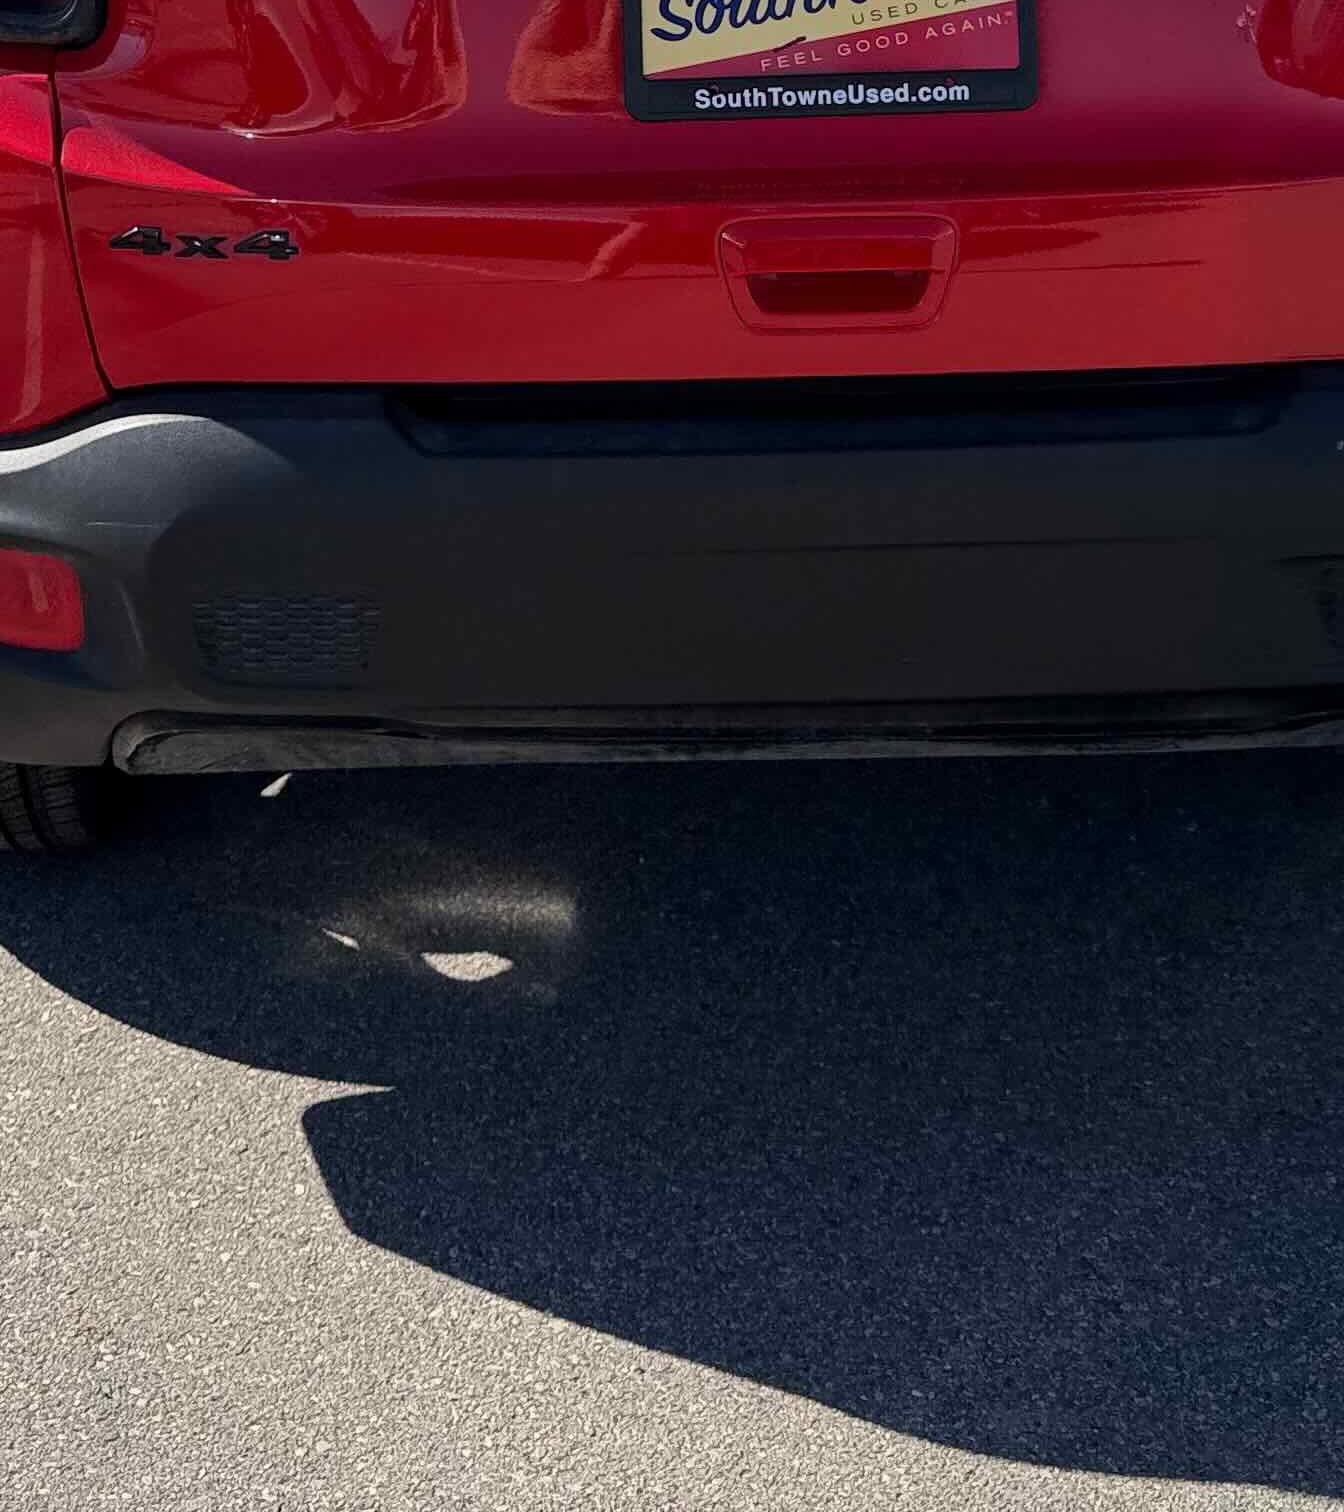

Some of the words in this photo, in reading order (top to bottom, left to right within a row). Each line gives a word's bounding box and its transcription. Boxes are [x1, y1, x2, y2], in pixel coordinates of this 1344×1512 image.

[851, 2, 919, 26] USED
[760, 51, 824, 72] FEEL
[837, 31, 909, 57] GOOD
[694, 83, 970, 110] SouthTowneUsed.com
[109, 226, 299, 261] 4x4
